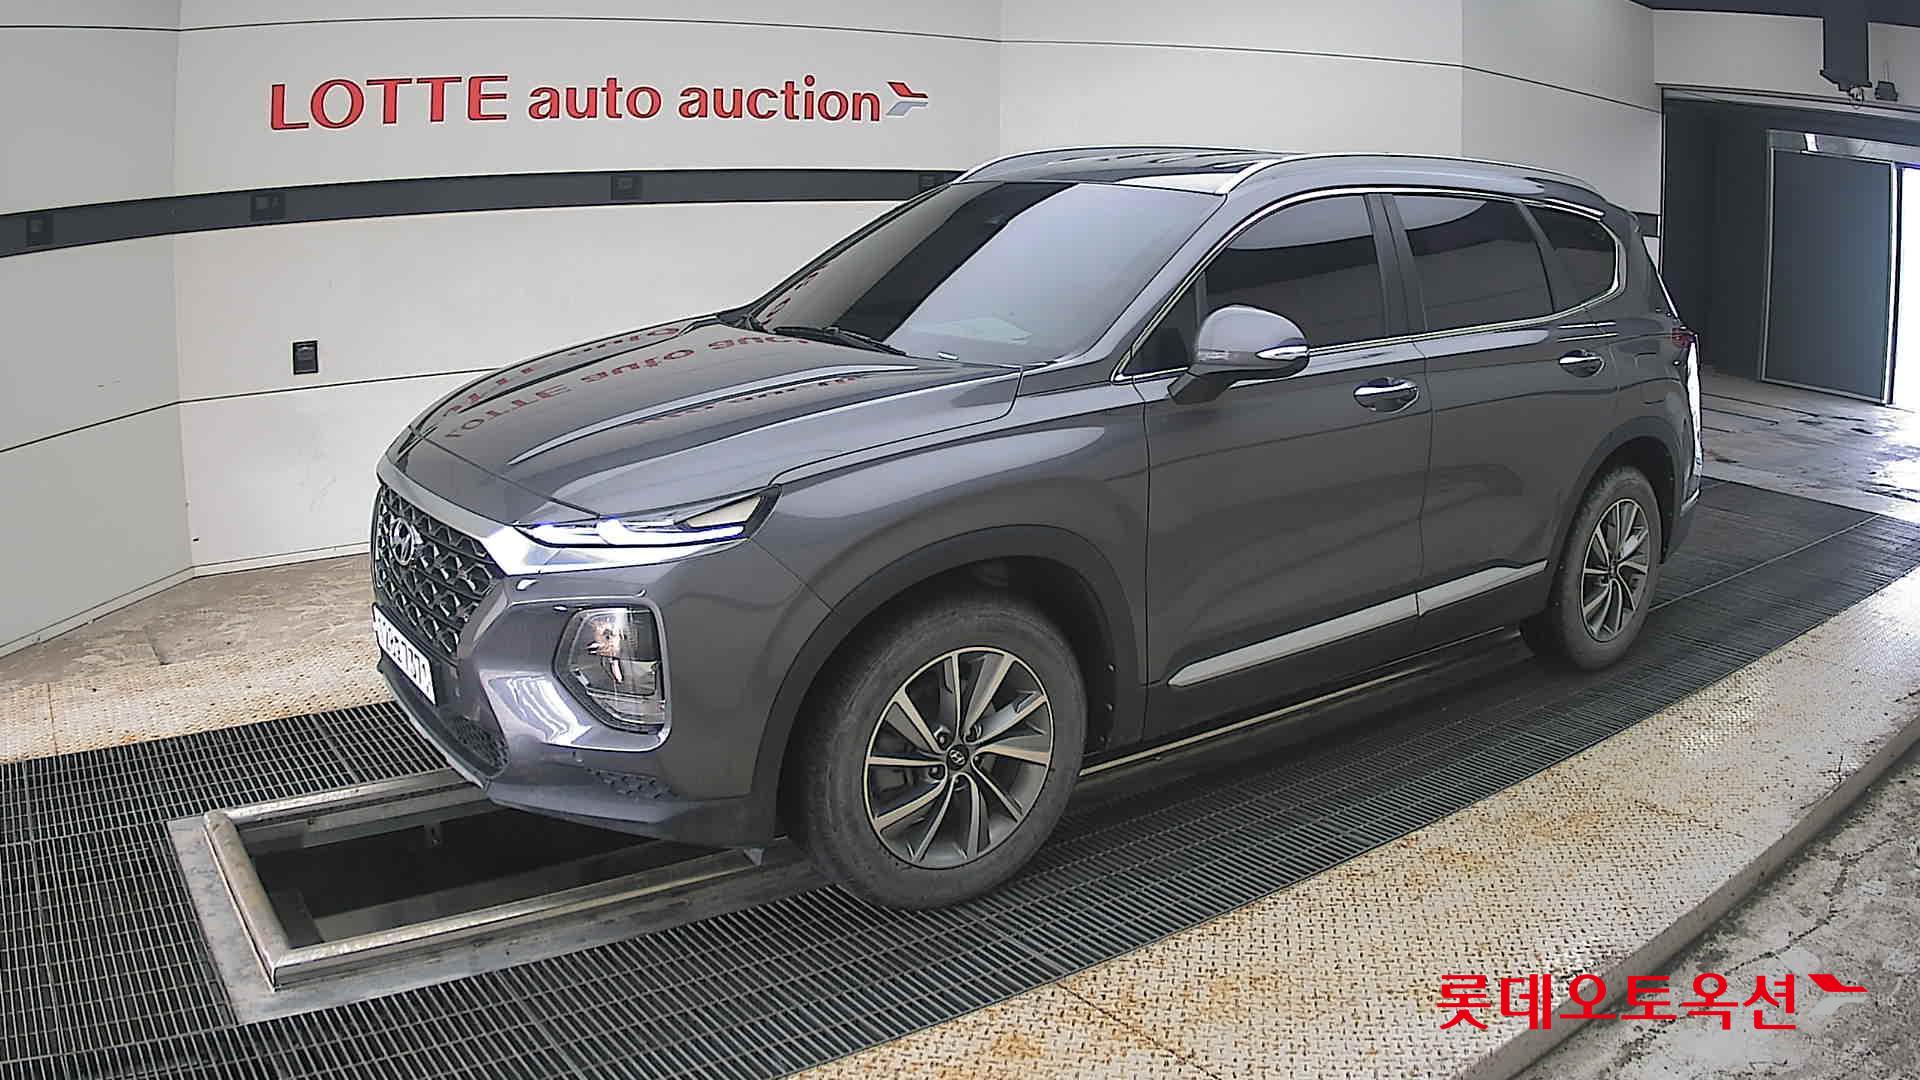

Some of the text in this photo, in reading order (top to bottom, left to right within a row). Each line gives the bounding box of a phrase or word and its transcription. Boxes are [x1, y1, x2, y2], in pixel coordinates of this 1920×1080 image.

[270, 75, 881, 130] LOTTE auto auction
